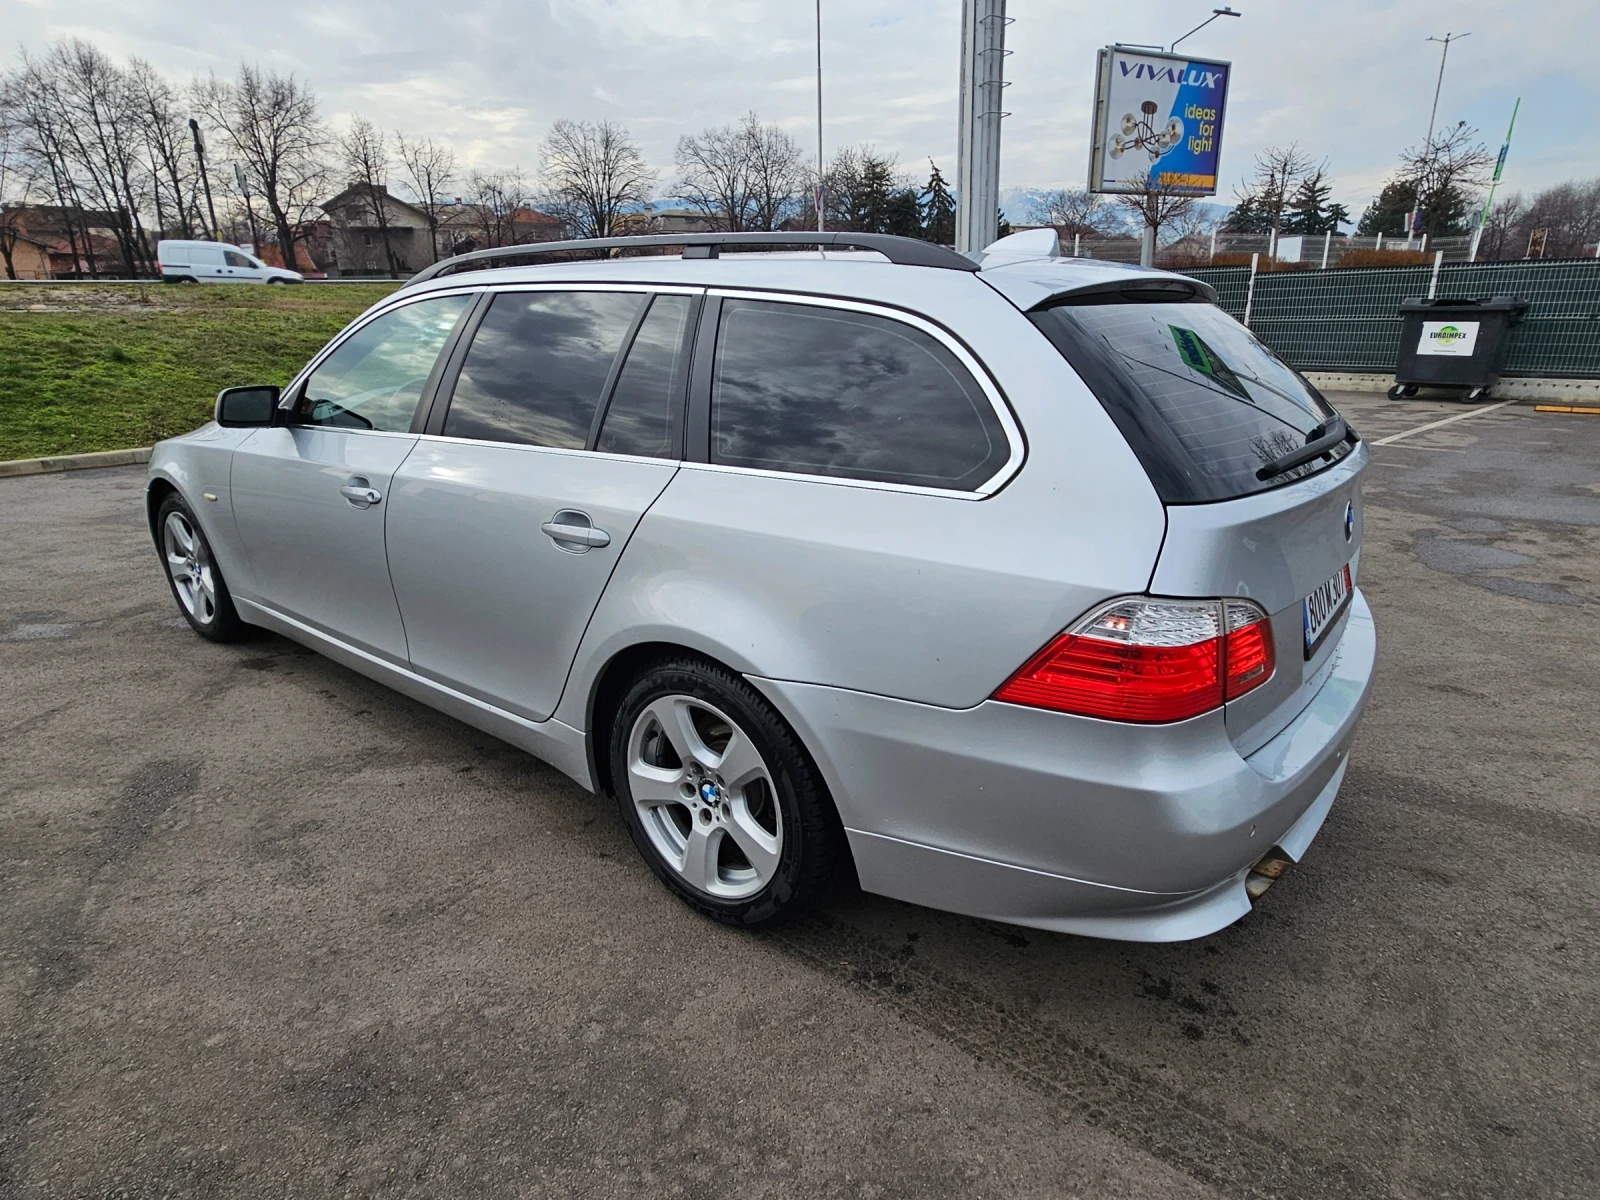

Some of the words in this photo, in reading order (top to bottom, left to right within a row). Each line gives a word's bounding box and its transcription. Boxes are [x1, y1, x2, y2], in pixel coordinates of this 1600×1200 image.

[1119, 61, 1219, 89] VIVALUX
[1184, 103, 1216, 121] ideas
[1199, 121, 1214, 136] for
[1188, 136, 1213, 155] light
